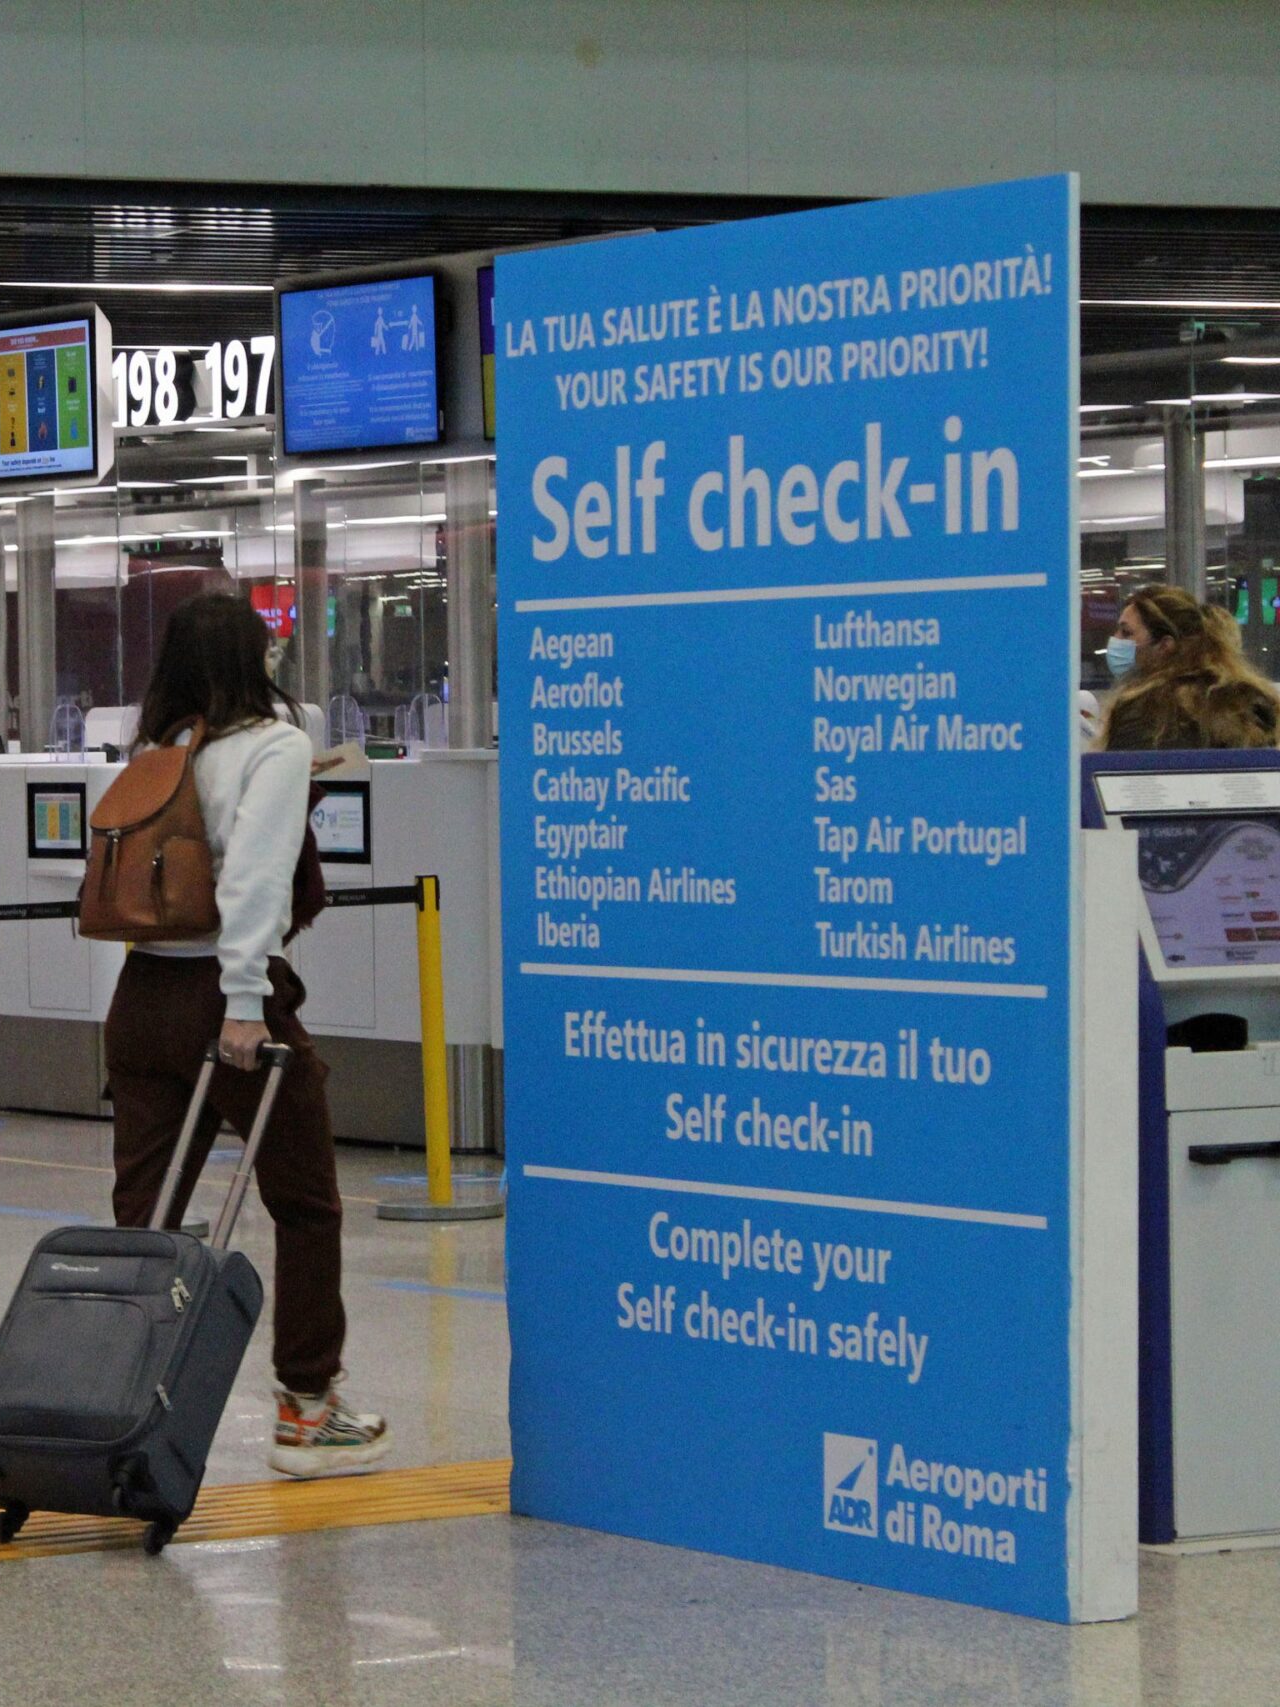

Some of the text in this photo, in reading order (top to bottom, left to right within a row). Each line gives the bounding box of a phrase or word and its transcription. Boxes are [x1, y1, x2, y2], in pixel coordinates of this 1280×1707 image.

[507, 245, 1051, 357] LA TUA SALUTE È LA NOSTRA PRIORITÀ!
[112, 349, 178, 427] 198
[205, 336, 276, 420] 197
[556, 328, 987, 409] YOUR SAFETY IS OUR PRIORITY!
[532, 416, 1018, 561] Self check-in
[530, 628, 613, 668] Aegean
[815, 611, 939, 649] Lufthansa
[532, 673, 622, 708] Aeroflot
[815, 663, 955, 710] Norwegian
[534, 721, 622, 755] Brussels
[815, 715, 1022, 762] Royal Air Maroc
[534, 766, 689, 811] Cathay Pacific
[816, 767, 856, 801] Sas
[536, 816, 626, 858] Egyptair
[815, 817, 1025, 865] Tap Air Portugal
[536, 866, 735, 909] Ethiopian Airlines
[815, 868, 892, 903] Tarom
[538, 913, 599, 947] Iberia
[816, 922, 1015, 964] Turkish Airlines
[566, 1011, 990, 1084] Effettua in sicurezza il tuo
[667, 1093, 872, 1155] Self check-in
[650, 1212, 890, 1291] Complete your
[618, 1283, 927, 1383] Self check-in safely
[887, 1445, 1046, 1511] Aeroporti
[828, 1493, 873, 1531] ADR
[886, 1502, 1015, 1563] di Roma
